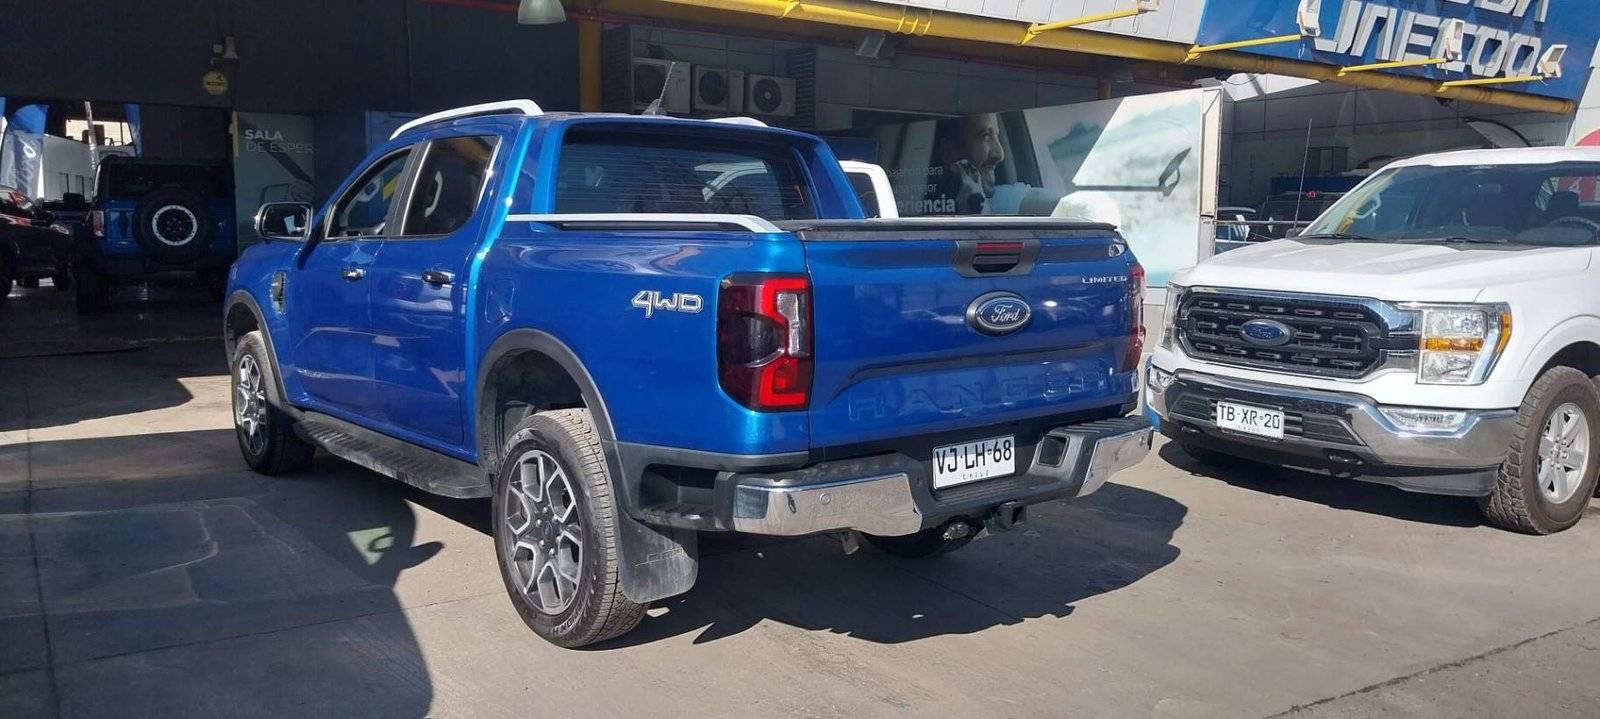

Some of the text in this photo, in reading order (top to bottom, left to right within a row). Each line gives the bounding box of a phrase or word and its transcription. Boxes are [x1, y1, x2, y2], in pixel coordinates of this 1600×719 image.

[244, 128, 283, 141] SALA
[246, 140, 266, 153] DE
[920, 166, 943, 178] para
[911, 182, 937, 195] mejor
[897, 193, 956, 213] eriencia
[1081, 275, 1127, 284] LIMITED
[631, 290, 704, 318] 4WD
[991, 304, 1020, 322] Ford
